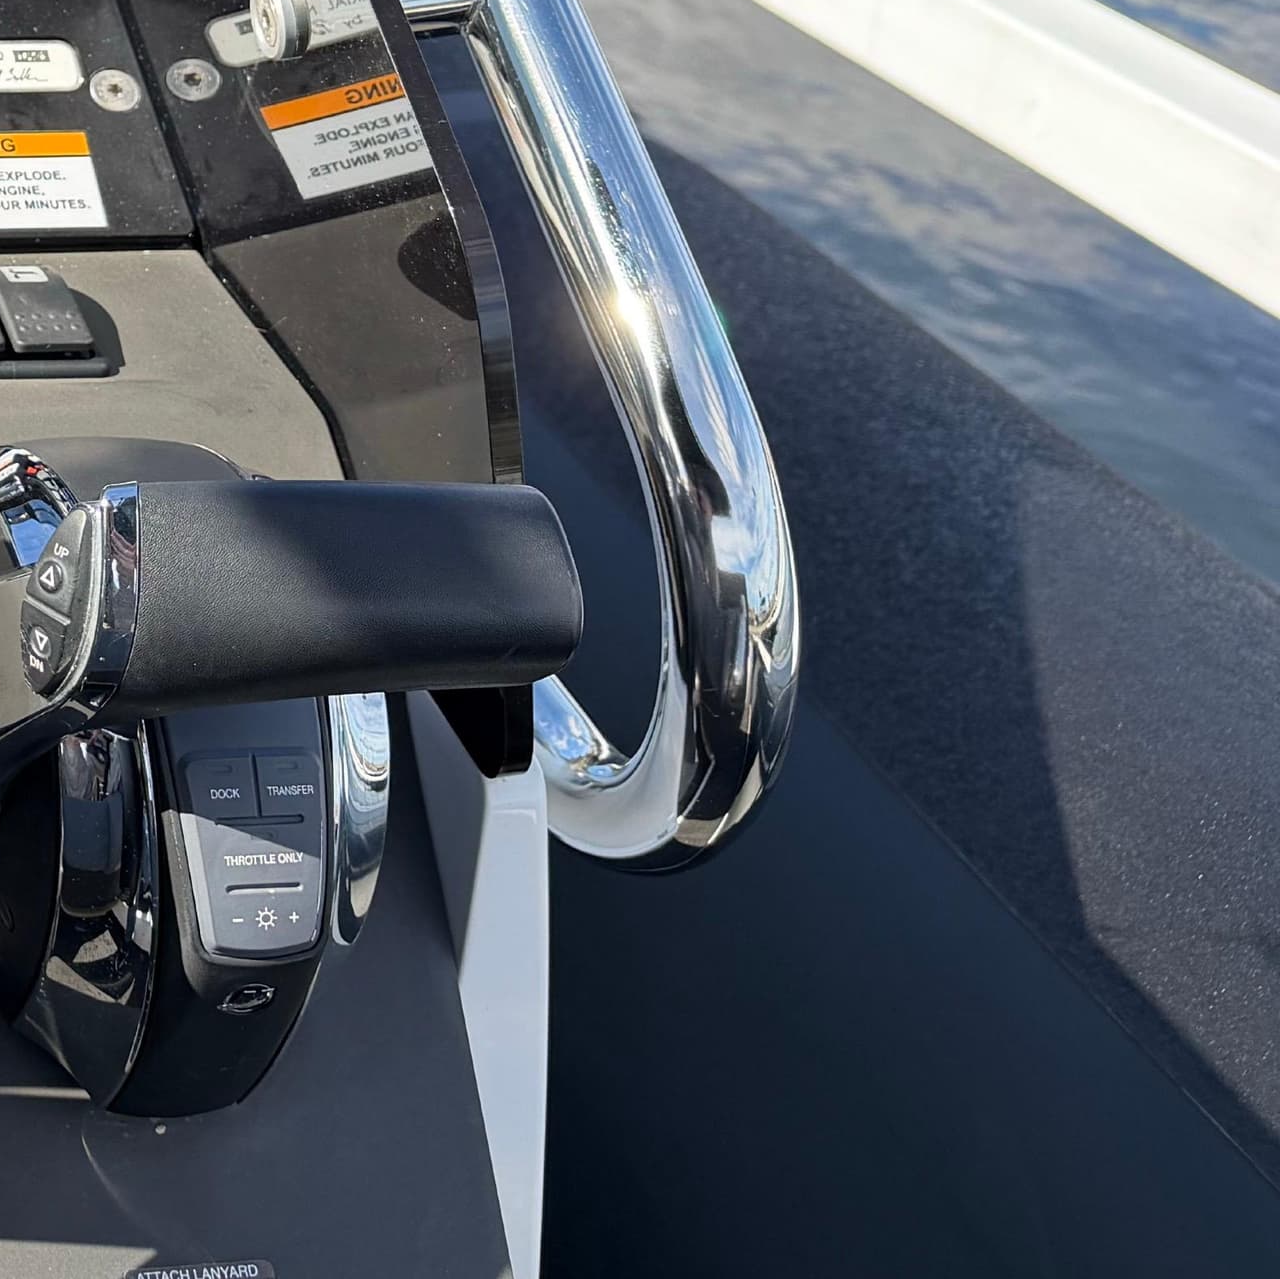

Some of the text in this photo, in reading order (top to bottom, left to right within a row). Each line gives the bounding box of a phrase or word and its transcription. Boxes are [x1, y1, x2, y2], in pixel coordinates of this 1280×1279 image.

[23, 199, 92, 210] MINUTES.
[53, 542, 70, 559] UP
[28, 655, 45, 673] DN
[209, 788, 241, 800] DOCK
[266, 784, 315, 797] TRANSFER
[223, 852, 304, 867] THROTTLE ONLY
[192, 1263, 259, 1279] LANYARD
